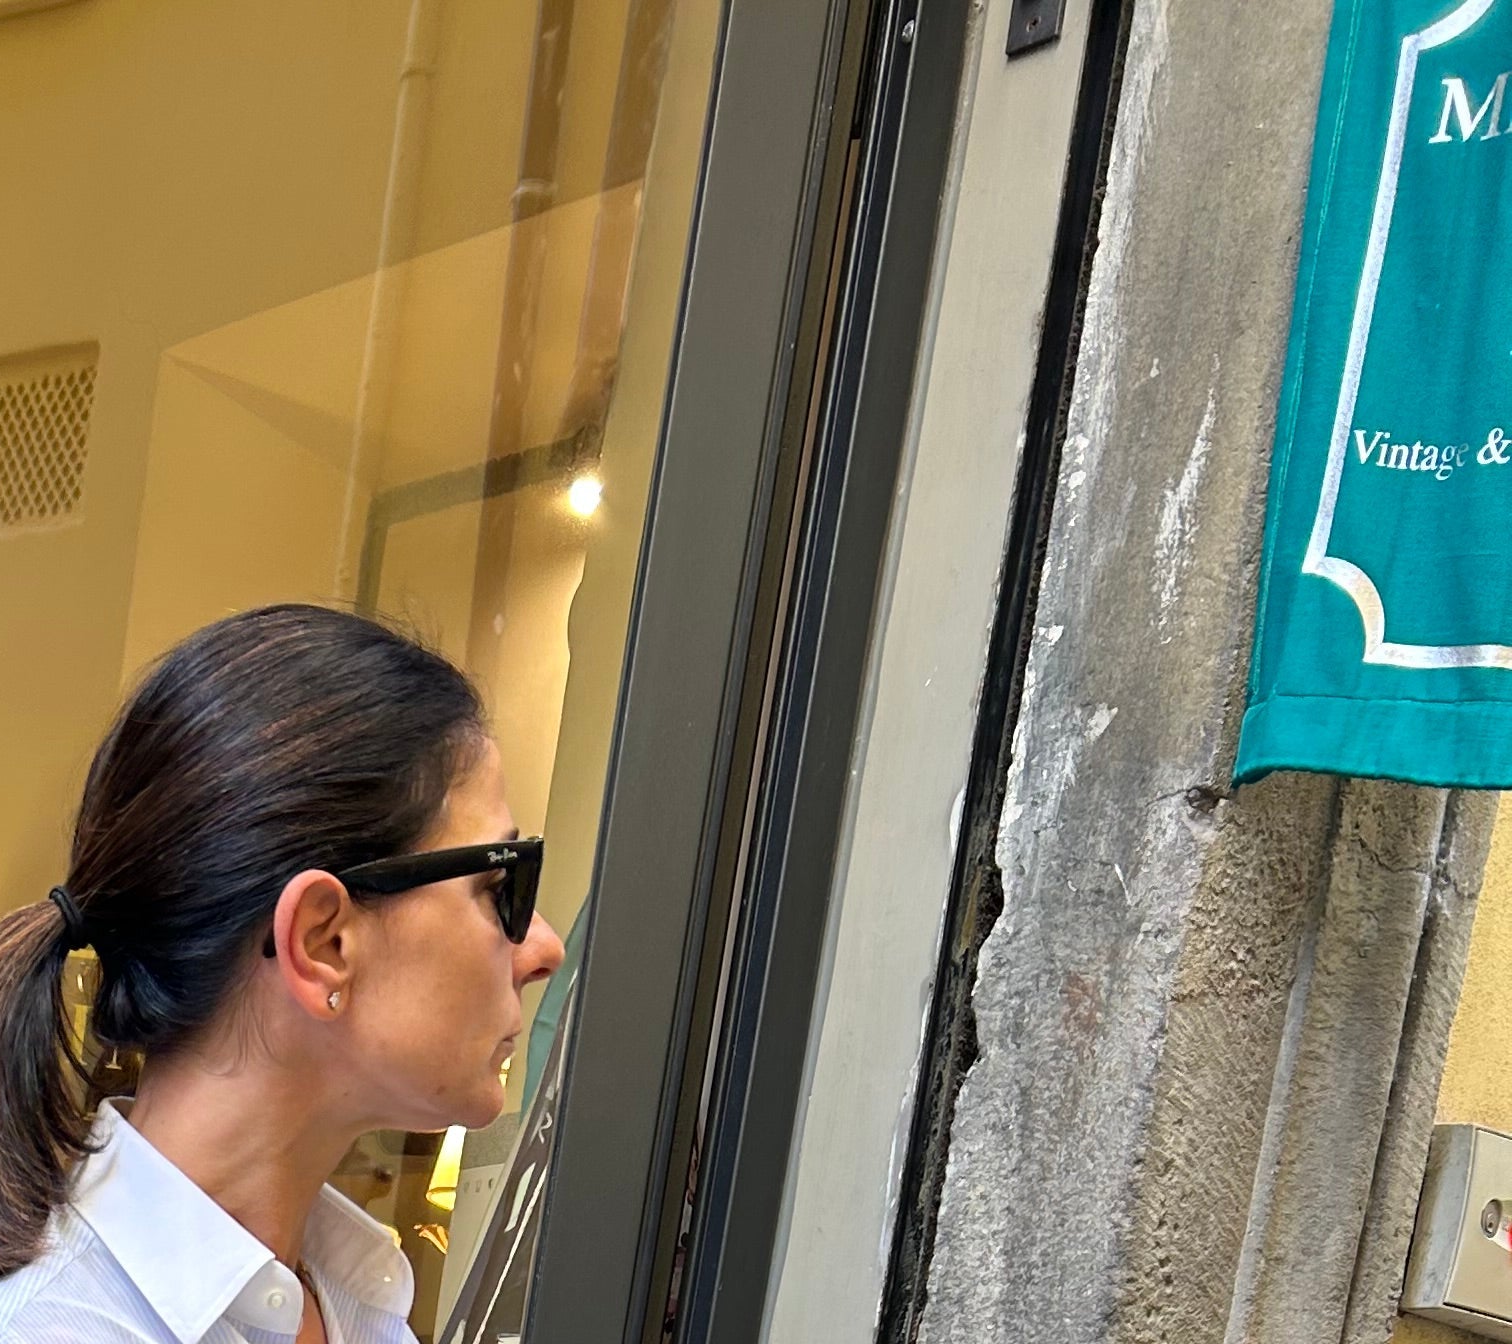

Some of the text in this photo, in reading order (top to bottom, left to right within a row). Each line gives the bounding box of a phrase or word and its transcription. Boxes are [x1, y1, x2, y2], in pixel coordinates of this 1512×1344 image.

[1429, 72, 1512, 143] M
[1353, 427, 1512, 481] Vintage &
